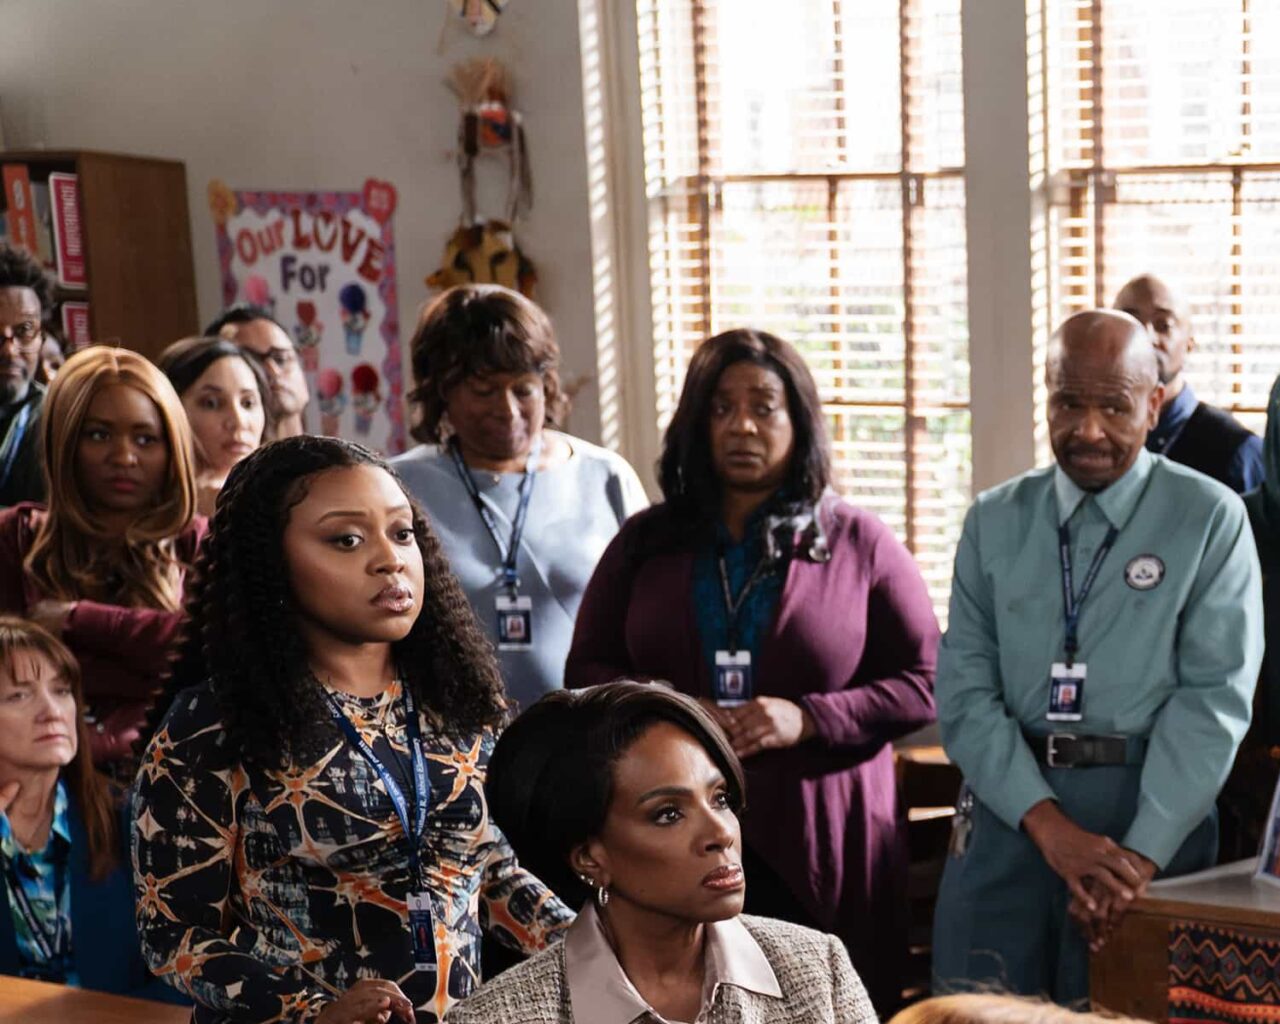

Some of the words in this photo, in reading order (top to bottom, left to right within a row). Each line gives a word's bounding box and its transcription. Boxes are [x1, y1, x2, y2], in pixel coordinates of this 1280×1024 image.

[236, 218, 285, 267] Our
[290, 208, 385, 283] LOVE
[280, 255, 330, 293] For
